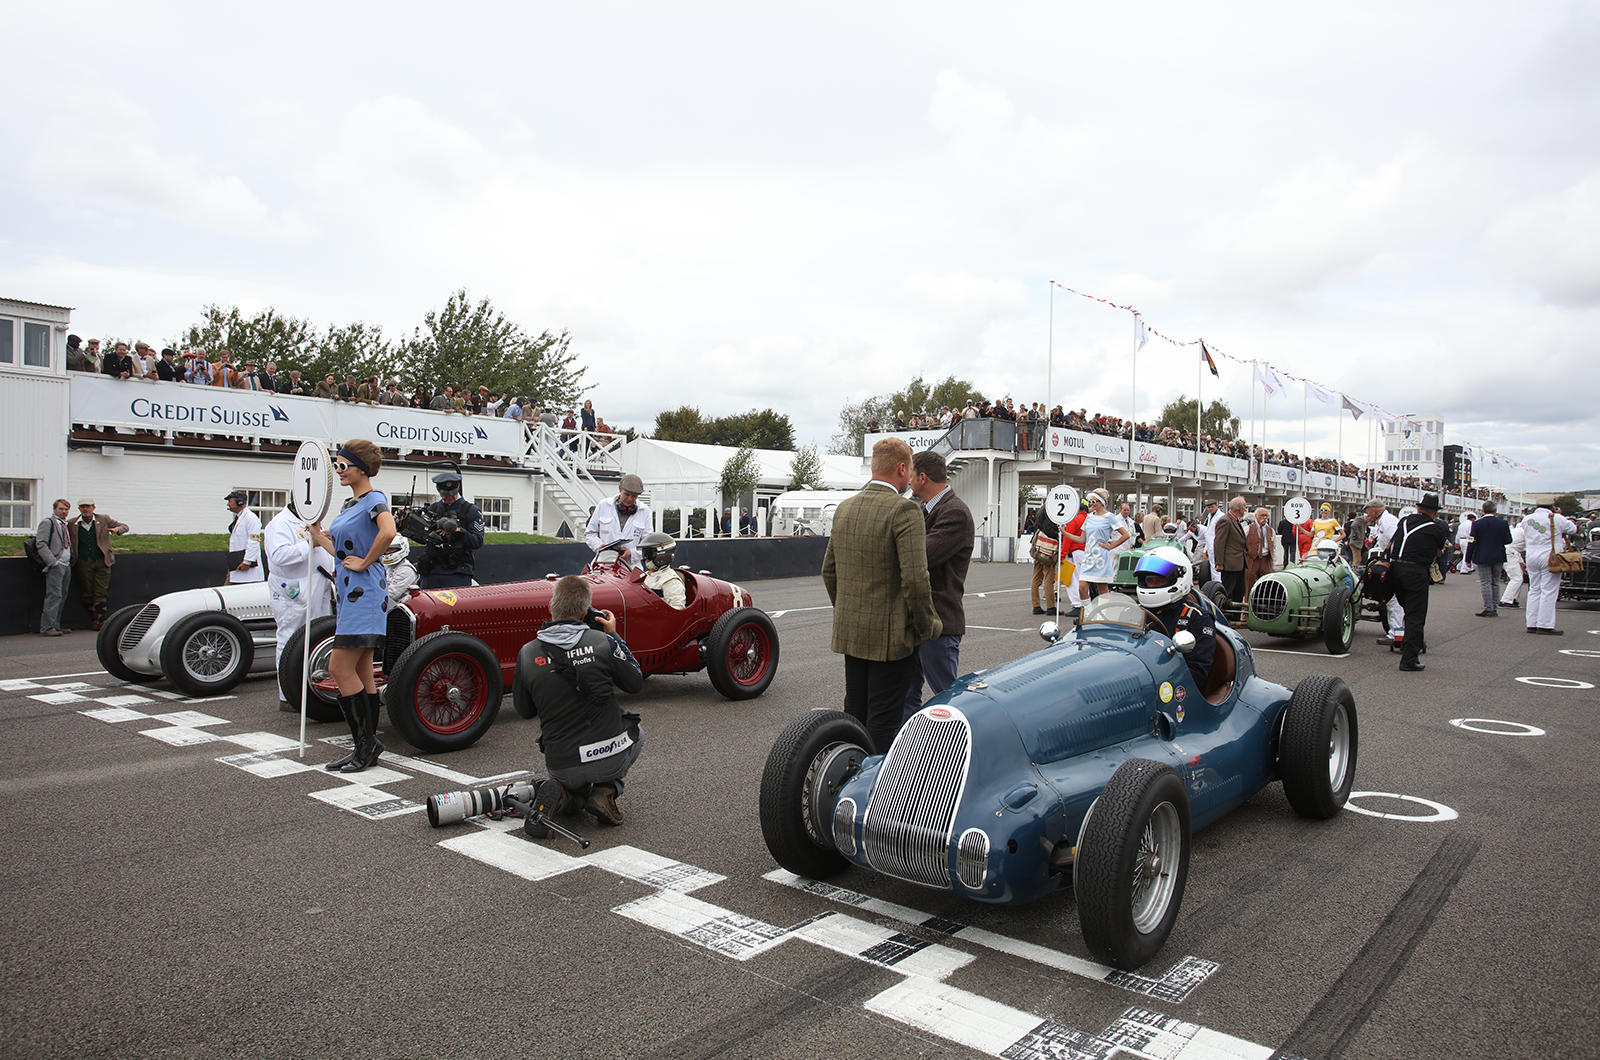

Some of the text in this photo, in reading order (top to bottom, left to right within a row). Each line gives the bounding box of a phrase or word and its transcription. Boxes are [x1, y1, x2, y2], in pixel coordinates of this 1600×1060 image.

[131, 398, 270, 428] CREDIT SUISSE
[376, 421, 474, 445] CREDIT SUISSE
[1063, 436, 1085, 449] MOTUL
[301, 456, 318, 471] ROW
[304, 477, 312, 505] 1
[1054, 493, 1070, 501] ROW
[1057, 502, 1065, 516] 2
[1295, 509, 1301, 519] 3
[729, 583, 743, 608] 8
